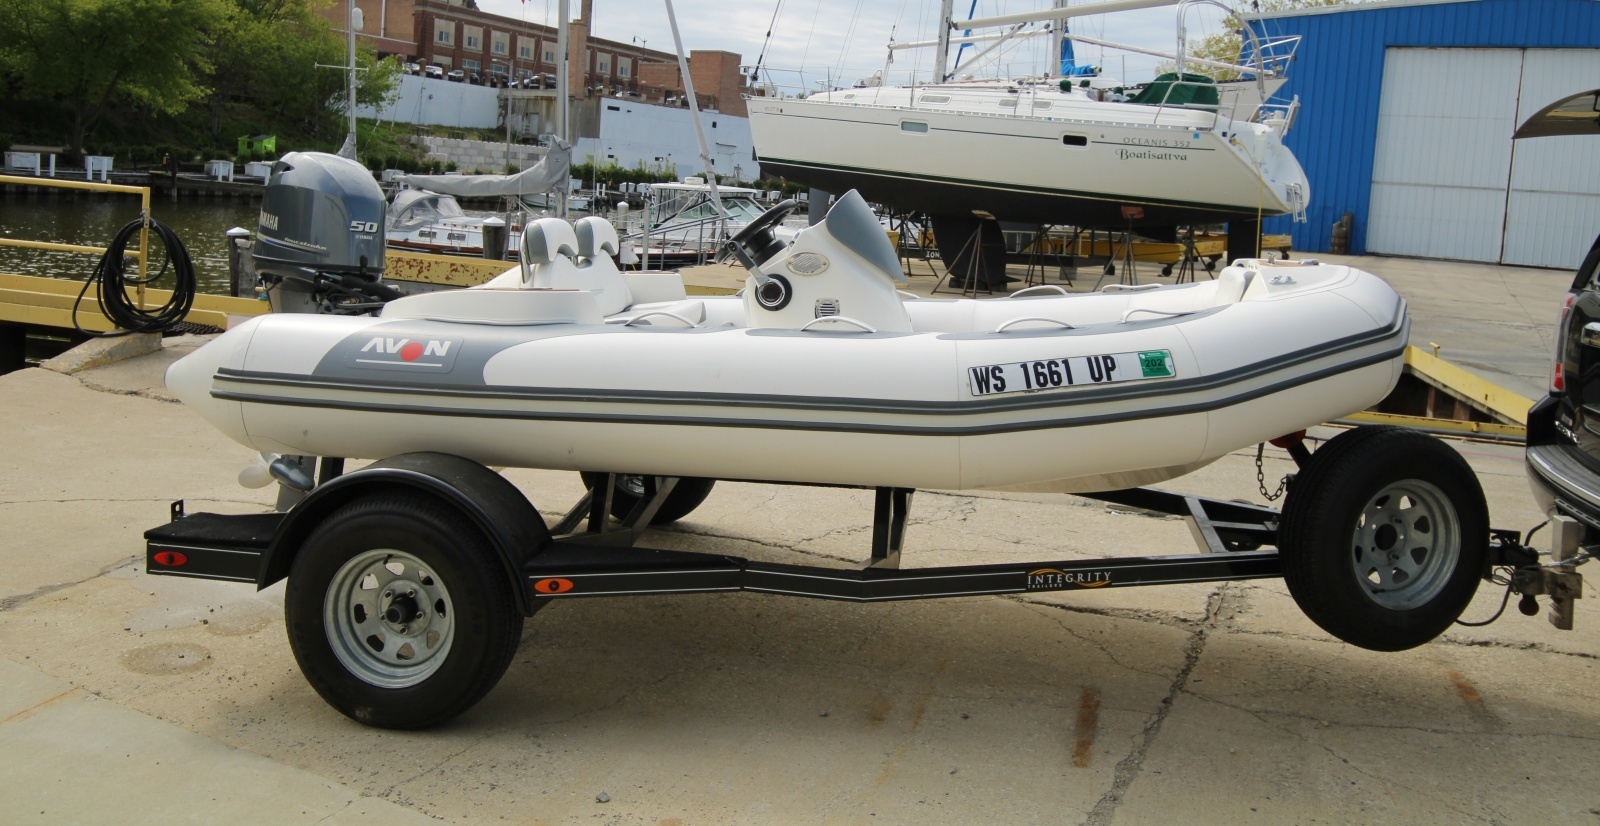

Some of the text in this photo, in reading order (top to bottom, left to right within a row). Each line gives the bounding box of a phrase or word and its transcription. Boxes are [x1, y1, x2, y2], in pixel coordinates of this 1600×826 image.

[1123, 136, 1191, 148] OCEANIS 352
[1115, 148, 1187, 161] Boatisattva
[350, 220, 378, 233] 50
[360, 336, 452, 363] AVON
[972, 355, 1117, 395] WS 1661 UP
[1027, 571, 1112, 584] INTEGRITY
